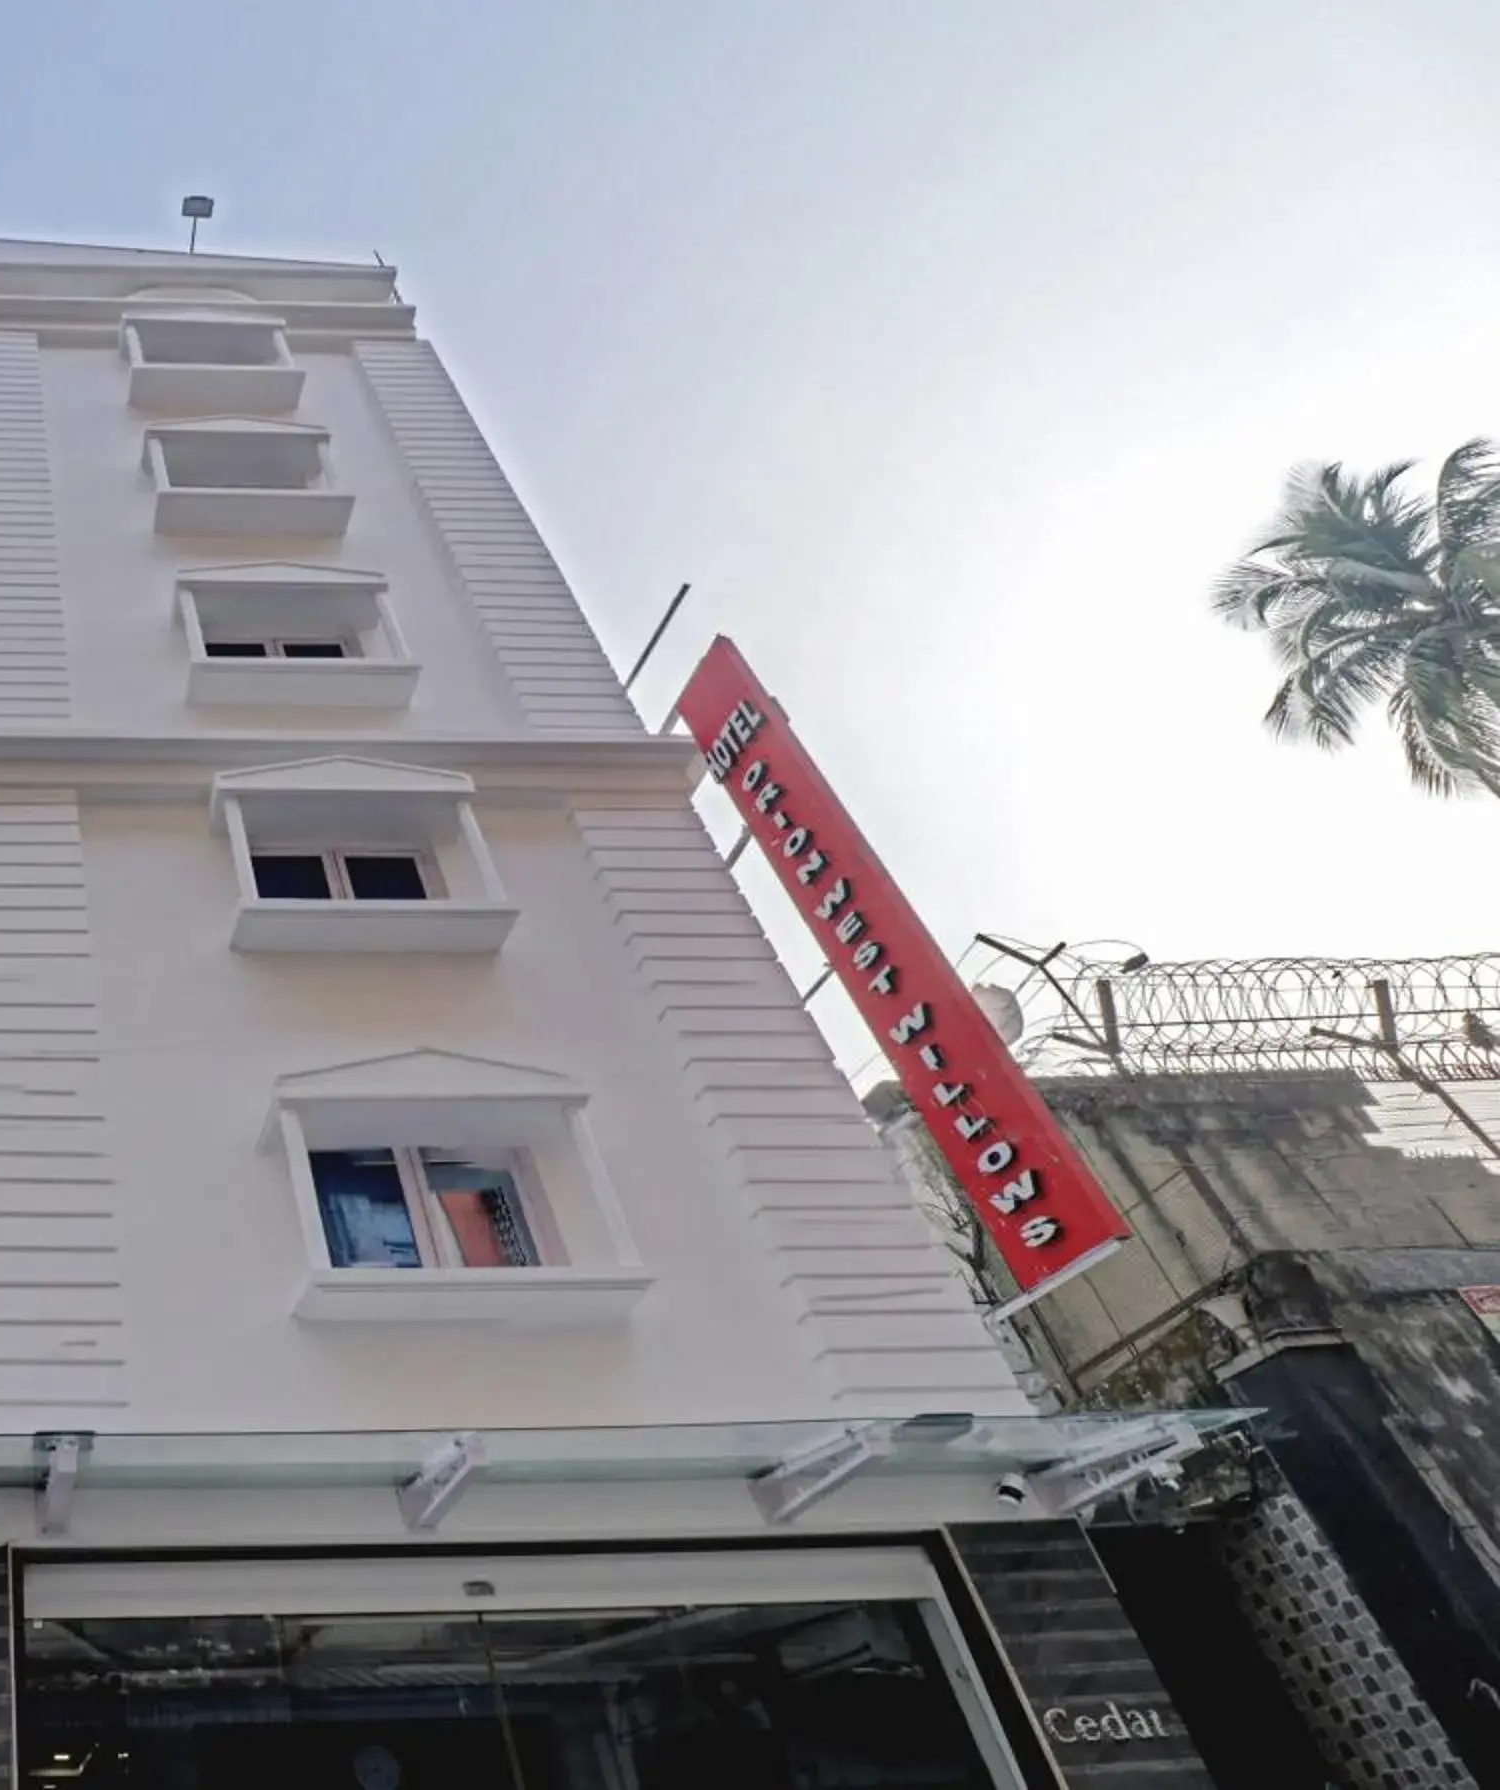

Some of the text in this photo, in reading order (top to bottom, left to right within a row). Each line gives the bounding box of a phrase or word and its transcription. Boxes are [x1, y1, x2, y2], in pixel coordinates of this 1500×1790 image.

[705, 700, 762, 784] HOTEL
[742, 760, 1060, 1248] ORION WEST WILLOWS
